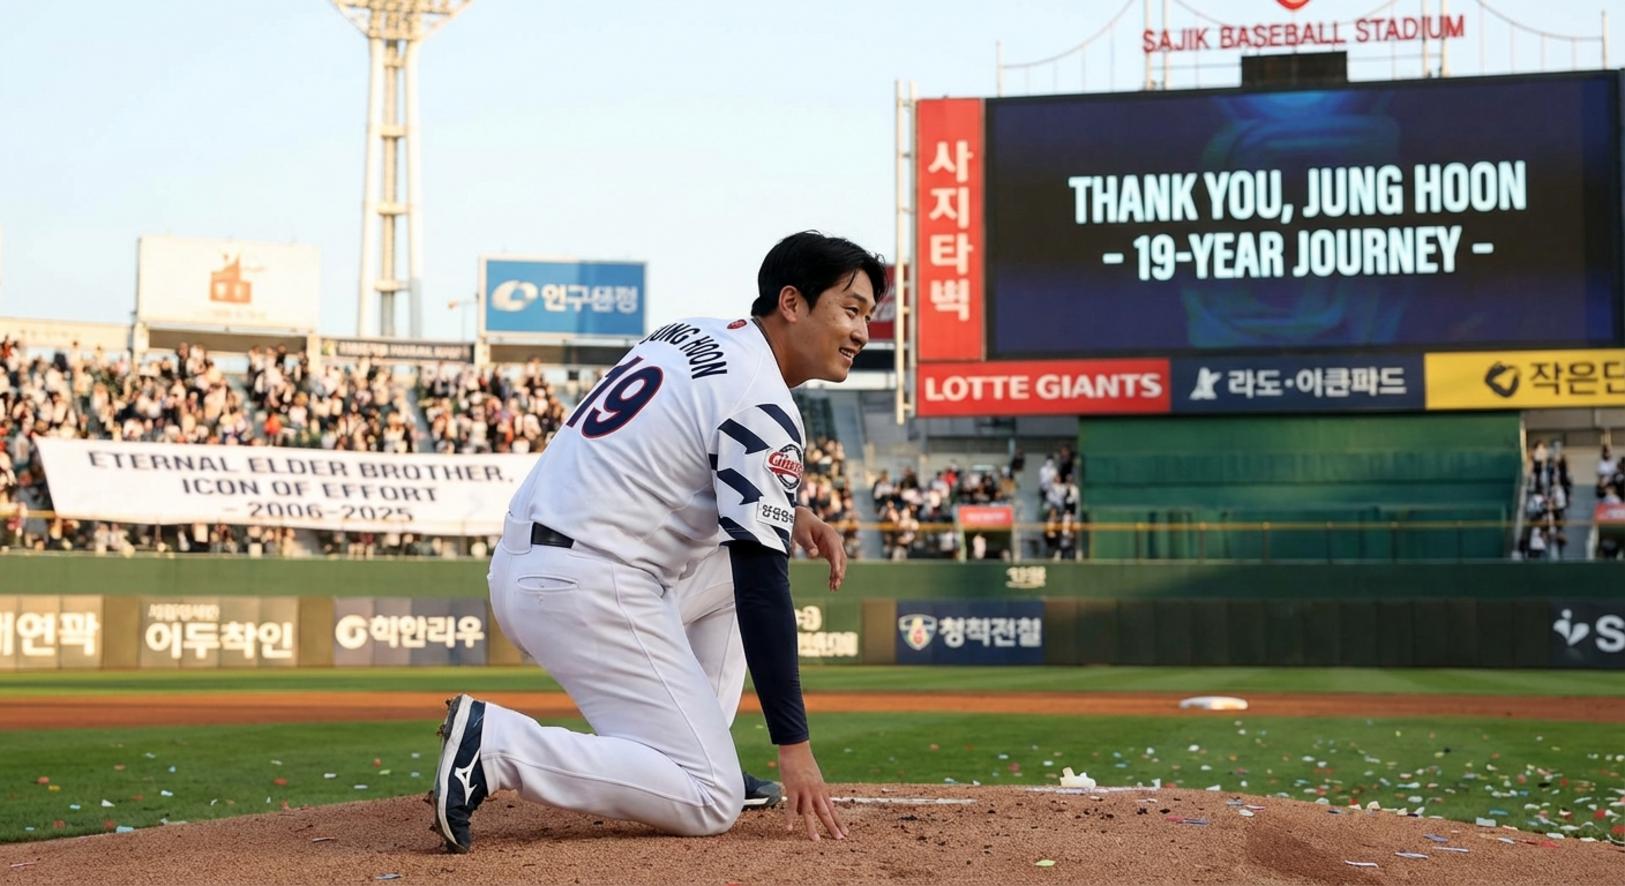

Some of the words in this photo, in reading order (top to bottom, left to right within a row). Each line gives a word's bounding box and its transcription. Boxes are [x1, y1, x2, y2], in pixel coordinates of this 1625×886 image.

[1143, 29, 1210, 53] SAJIK
[1220, 23, 1346, 49] BASEBALL
[1355, 15, 1464, 43] STADIUM
[1068, 173, 1199, 224] THANK
[1203, 169, 1294, 224] YOU,
[1302, 165, 1404, 218] JUNG
[1414, 160, 1527, 214] HOON
[1133, 231, 1284, 281] 19-YEAR
[1292, 225, 1463, 277] JOURNEY
[679, 335, 728, 379] HOON
[564, 355, 664, 439] 19
[925, 375, 1029, 401] LOTTE
[1035, 373, 1163, 399] GIANTS
[88, 451, 239, 472] ETERNAL
[248, 457, 348, 477] ELDER
[182, 478, 260, 496] ICON
[271, 480, 308, 497] OF
[322, 482, 438, 502] EFFORT
[248, 501, 414, 522] 2006-2025
